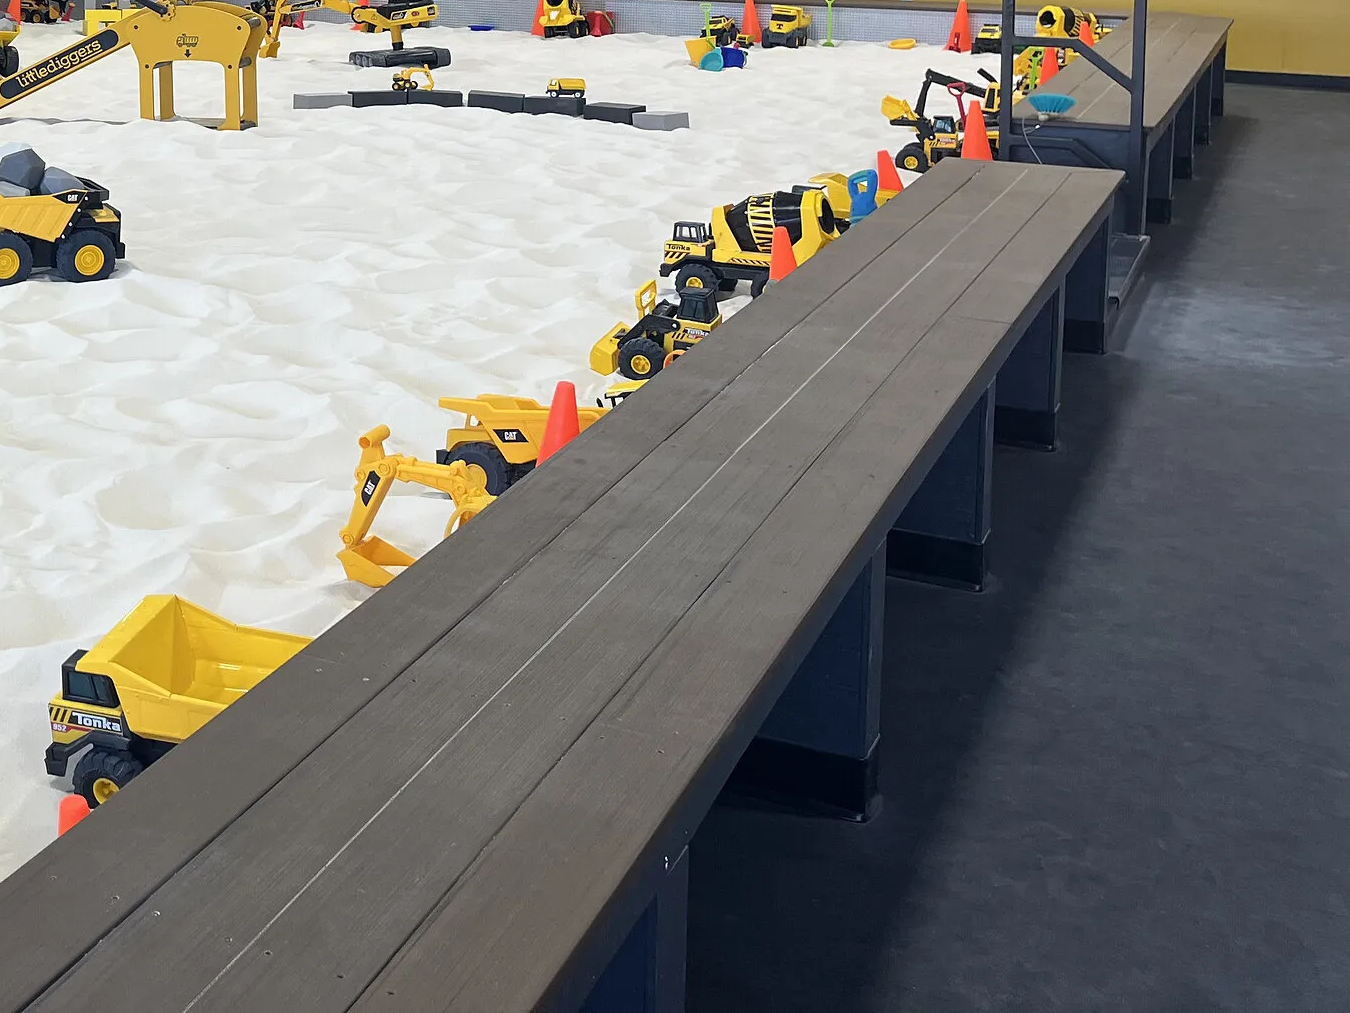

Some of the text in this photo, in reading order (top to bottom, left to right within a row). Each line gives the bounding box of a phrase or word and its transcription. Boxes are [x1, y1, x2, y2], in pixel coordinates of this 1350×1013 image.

[15, 39, 103, 88] littlediggers
[504, 431, 517, 440] CAT
[364, 480, 376, 496] CAT
[52, 723, 67, 732] 952
[72, 711, 121, 732] Tonka
